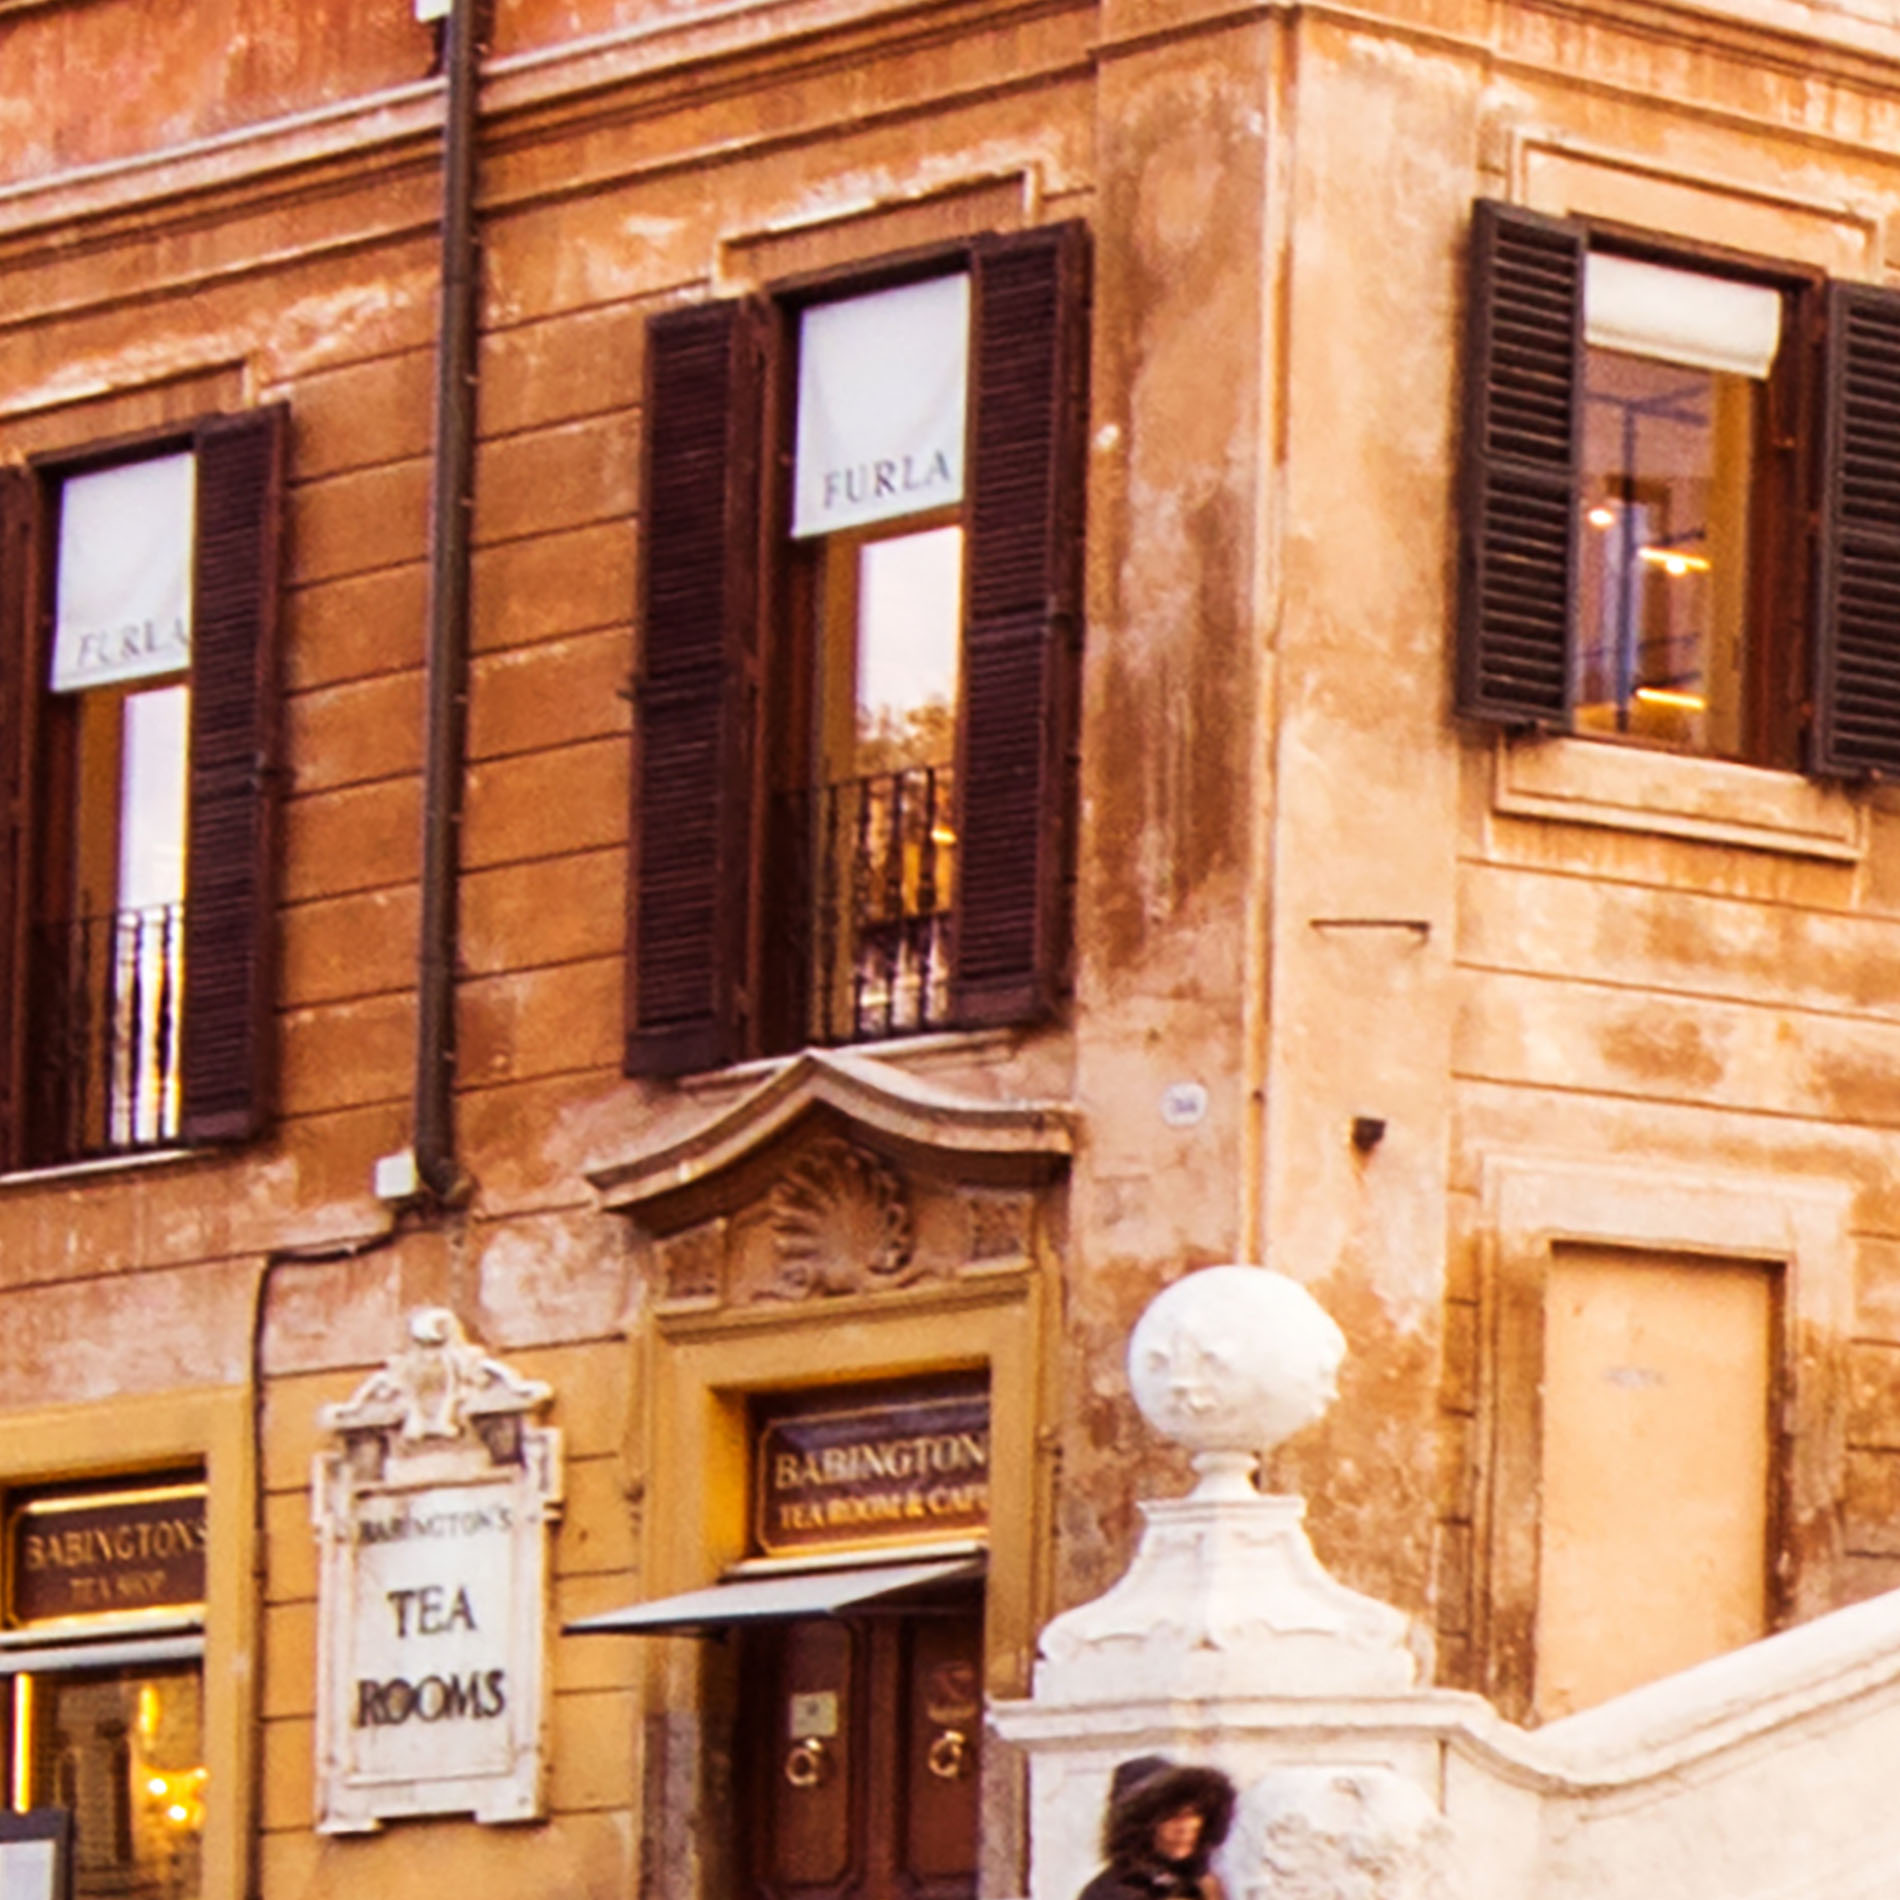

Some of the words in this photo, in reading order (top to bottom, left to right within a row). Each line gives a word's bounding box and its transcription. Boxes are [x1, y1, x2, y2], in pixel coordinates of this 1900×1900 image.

[823, 449, 950, 509] FURLA
[780, 1502, 824, 1529] TEA
[386, 1584, 478, 1639] TEA
[354, 1668, 506, 1728] ROOMS
